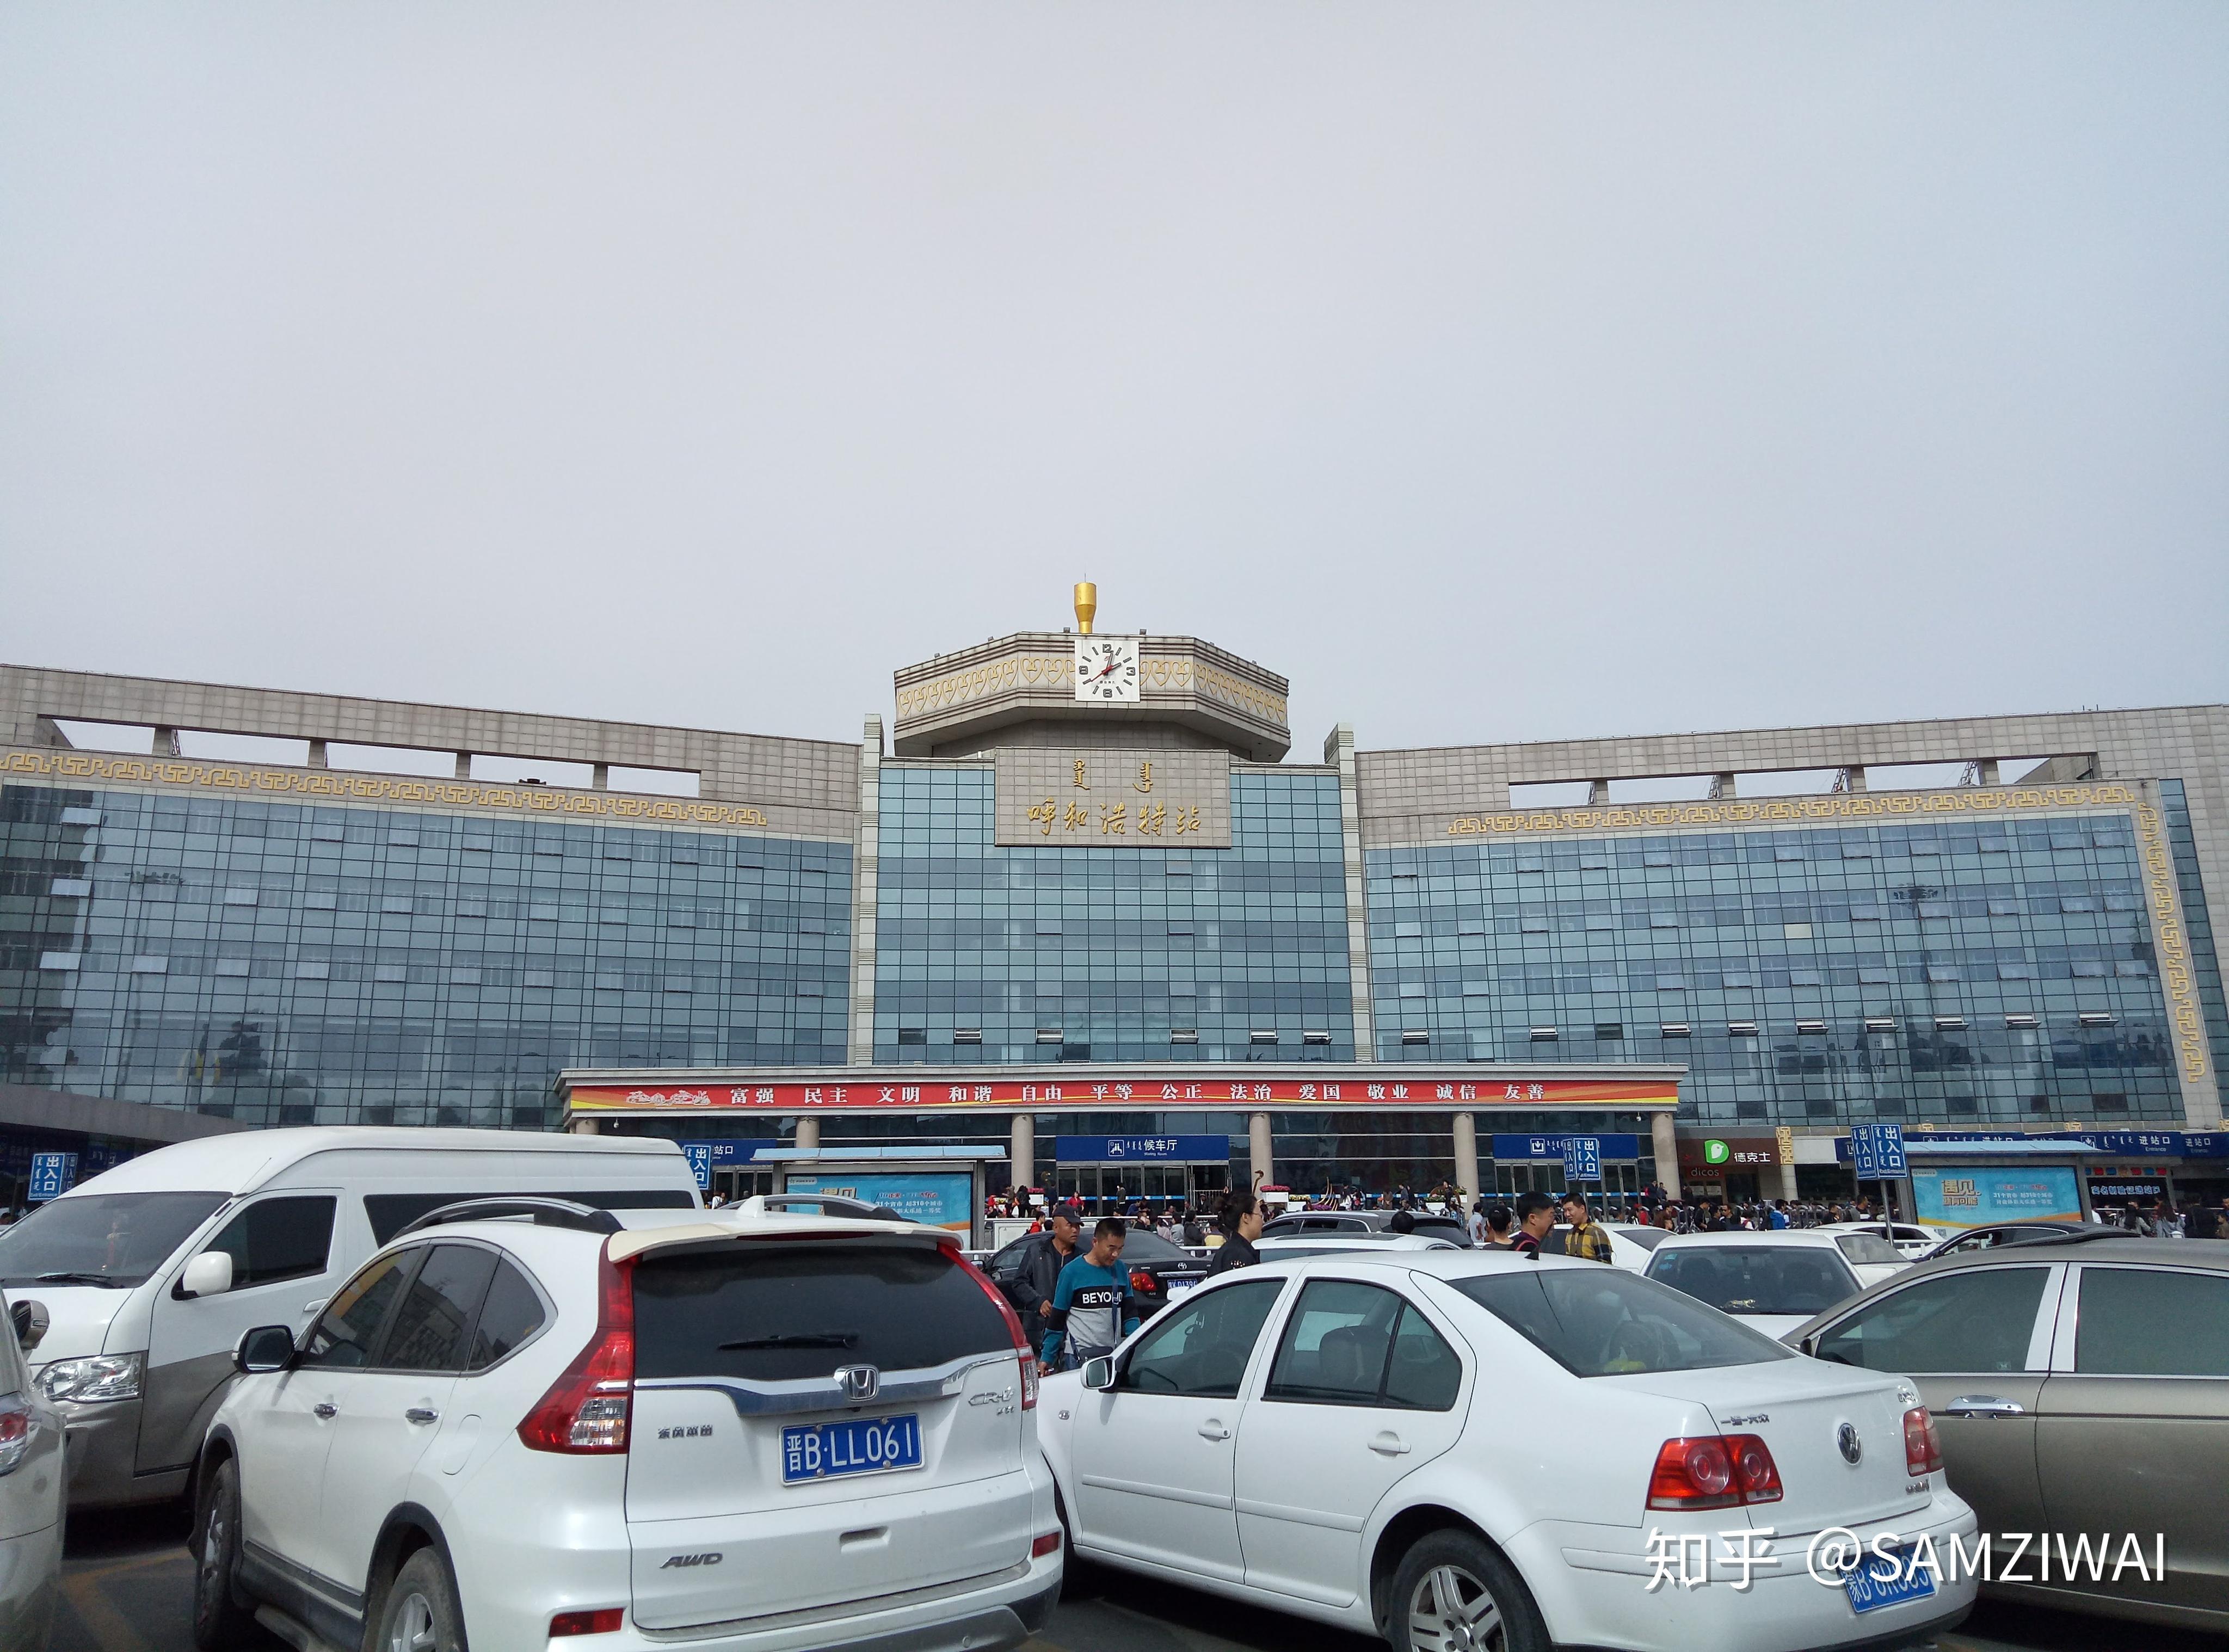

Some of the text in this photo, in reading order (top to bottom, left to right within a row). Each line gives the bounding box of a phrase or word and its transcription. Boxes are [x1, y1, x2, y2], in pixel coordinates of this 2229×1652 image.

[1103, 644, 1112, 653] 12
[1079, 665, 1088, 675] 9
[1126, 667, 1135, 676] 3
[1103, 689, 1112, 698] 6
[1026, 797, 1201, 835] 呼和浩特站
[730, 1083, 1545, 1105] 富强 民主 文明 和谐 自由 平等 公正 法治 爱国 敬业 诚信 友善
[1144, 1139, 1177, 1151] 候车厅
[1885, 1126, 1901, 1167] 出入口
[2139, 1136, 2170, 1145] 进站口
[2185, 1138, 2210, 1146] 进站口
[713, 1145, 733, 1155] 站口
[1859, 1127, 1871, 1168] 出入口
[1584, 1140, 1596, 1172] 出入口
[1734, 1152, 1771, 1162] 德克士
[694, 1148, 706, 1181] 出入口
[44, 1155, 59, 1191] 出入口
[1691, 1168, 1719, 1176] dicos
[968, 1385, 1014, 1406] CR-V
[659, 1552, 723, 1569] AWD
